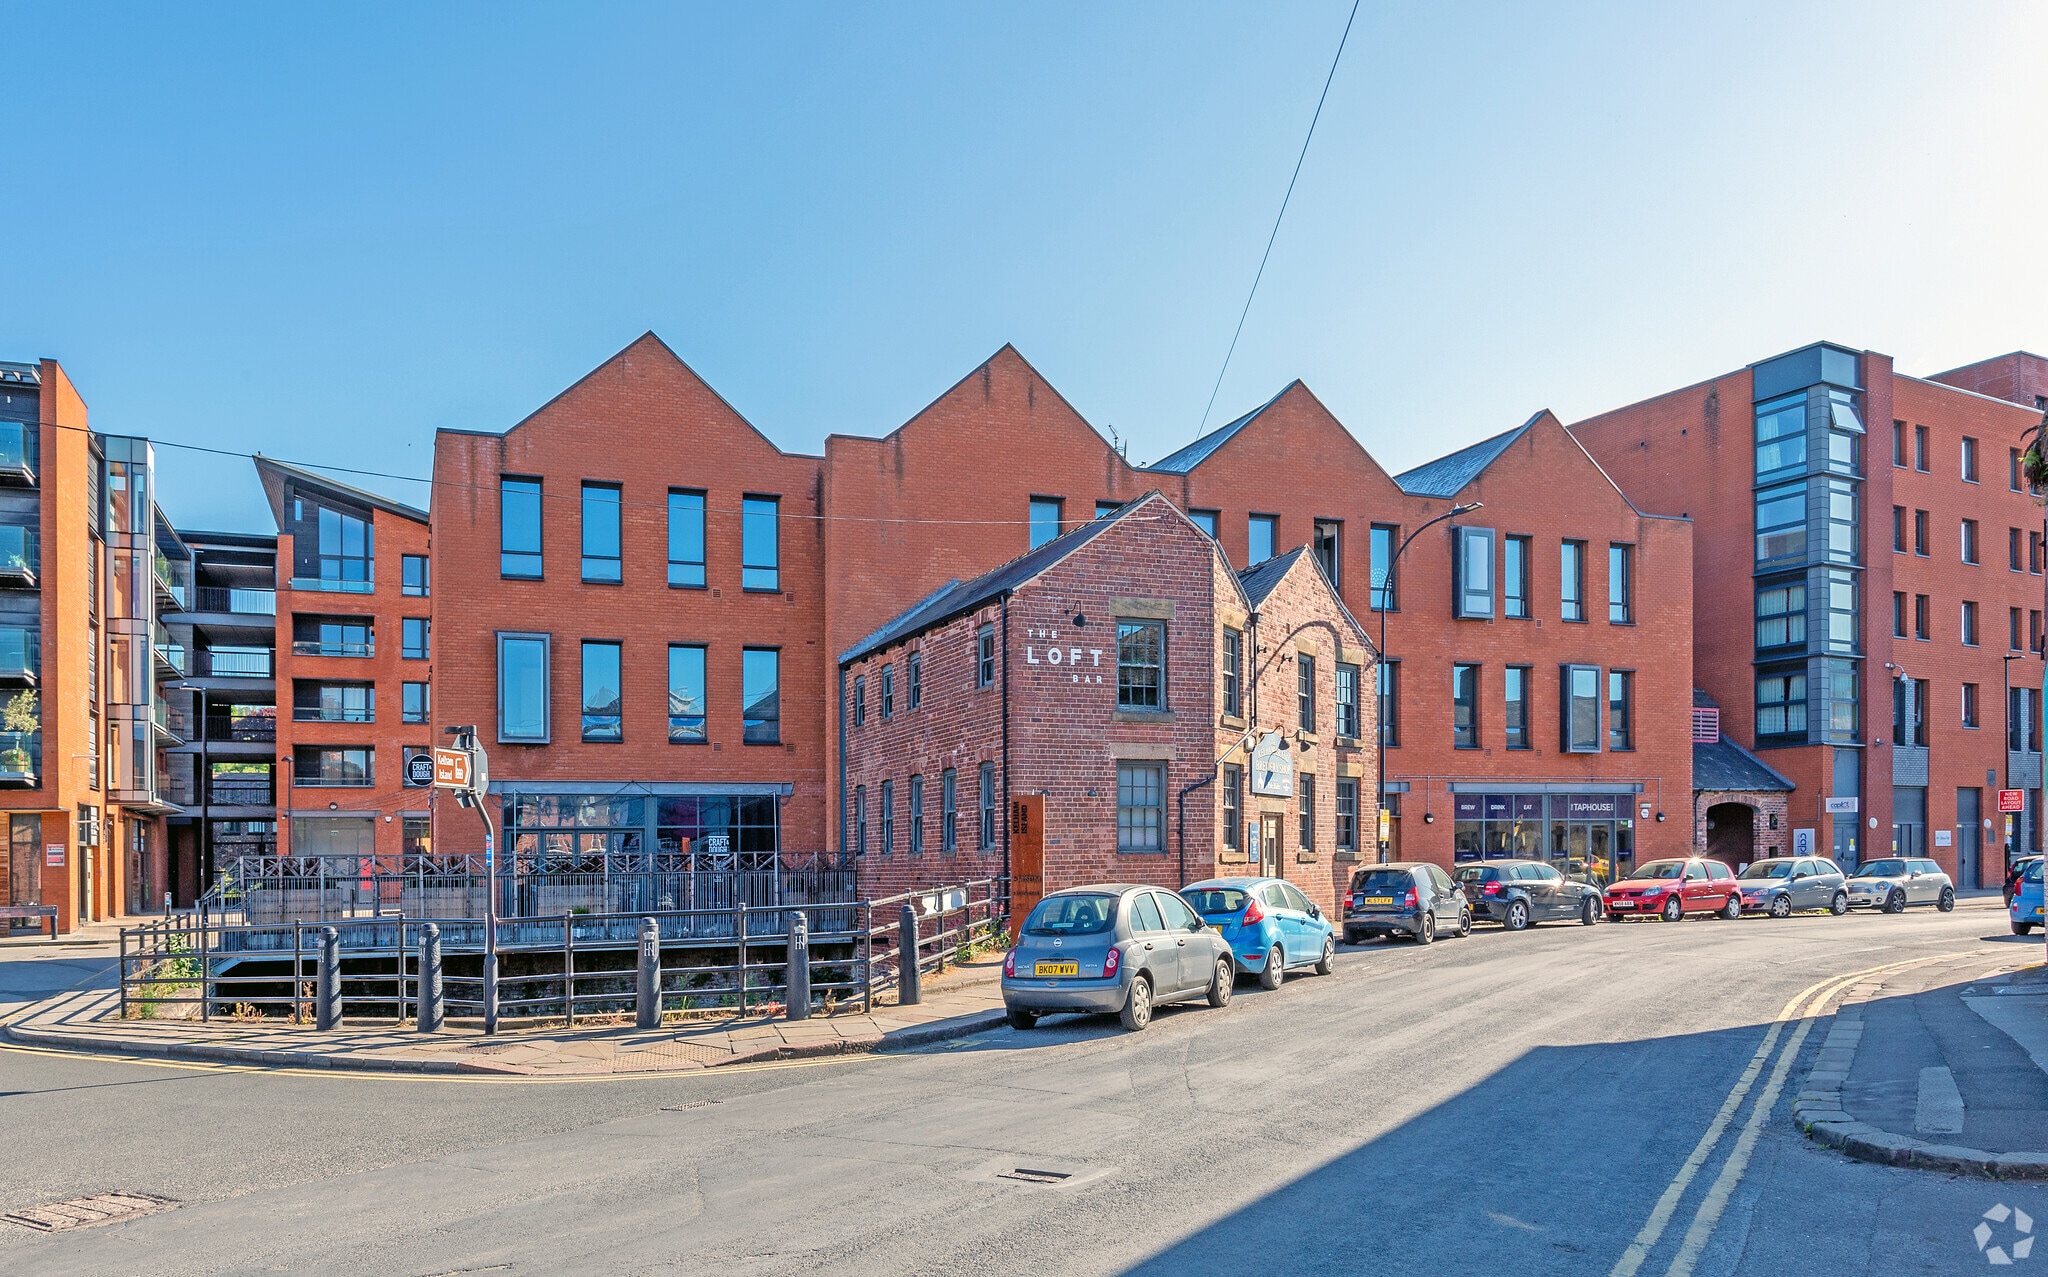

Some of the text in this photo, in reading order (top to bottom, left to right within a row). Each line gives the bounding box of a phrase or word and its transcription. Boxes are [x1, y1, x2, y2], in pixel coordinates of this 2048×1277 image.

[1027, 629, 1058, 639] THE
[1027, 646, 1103, 667] LOFT
[1072, 674, 1103, 684] BAR
[437, 754, 454, 766] Kelham
[439, 768, 453, 780] Island
[1574, 803, 1611, 811] TAPHOUSE
[1038, 965, 1075, 974] BK07 WVV
